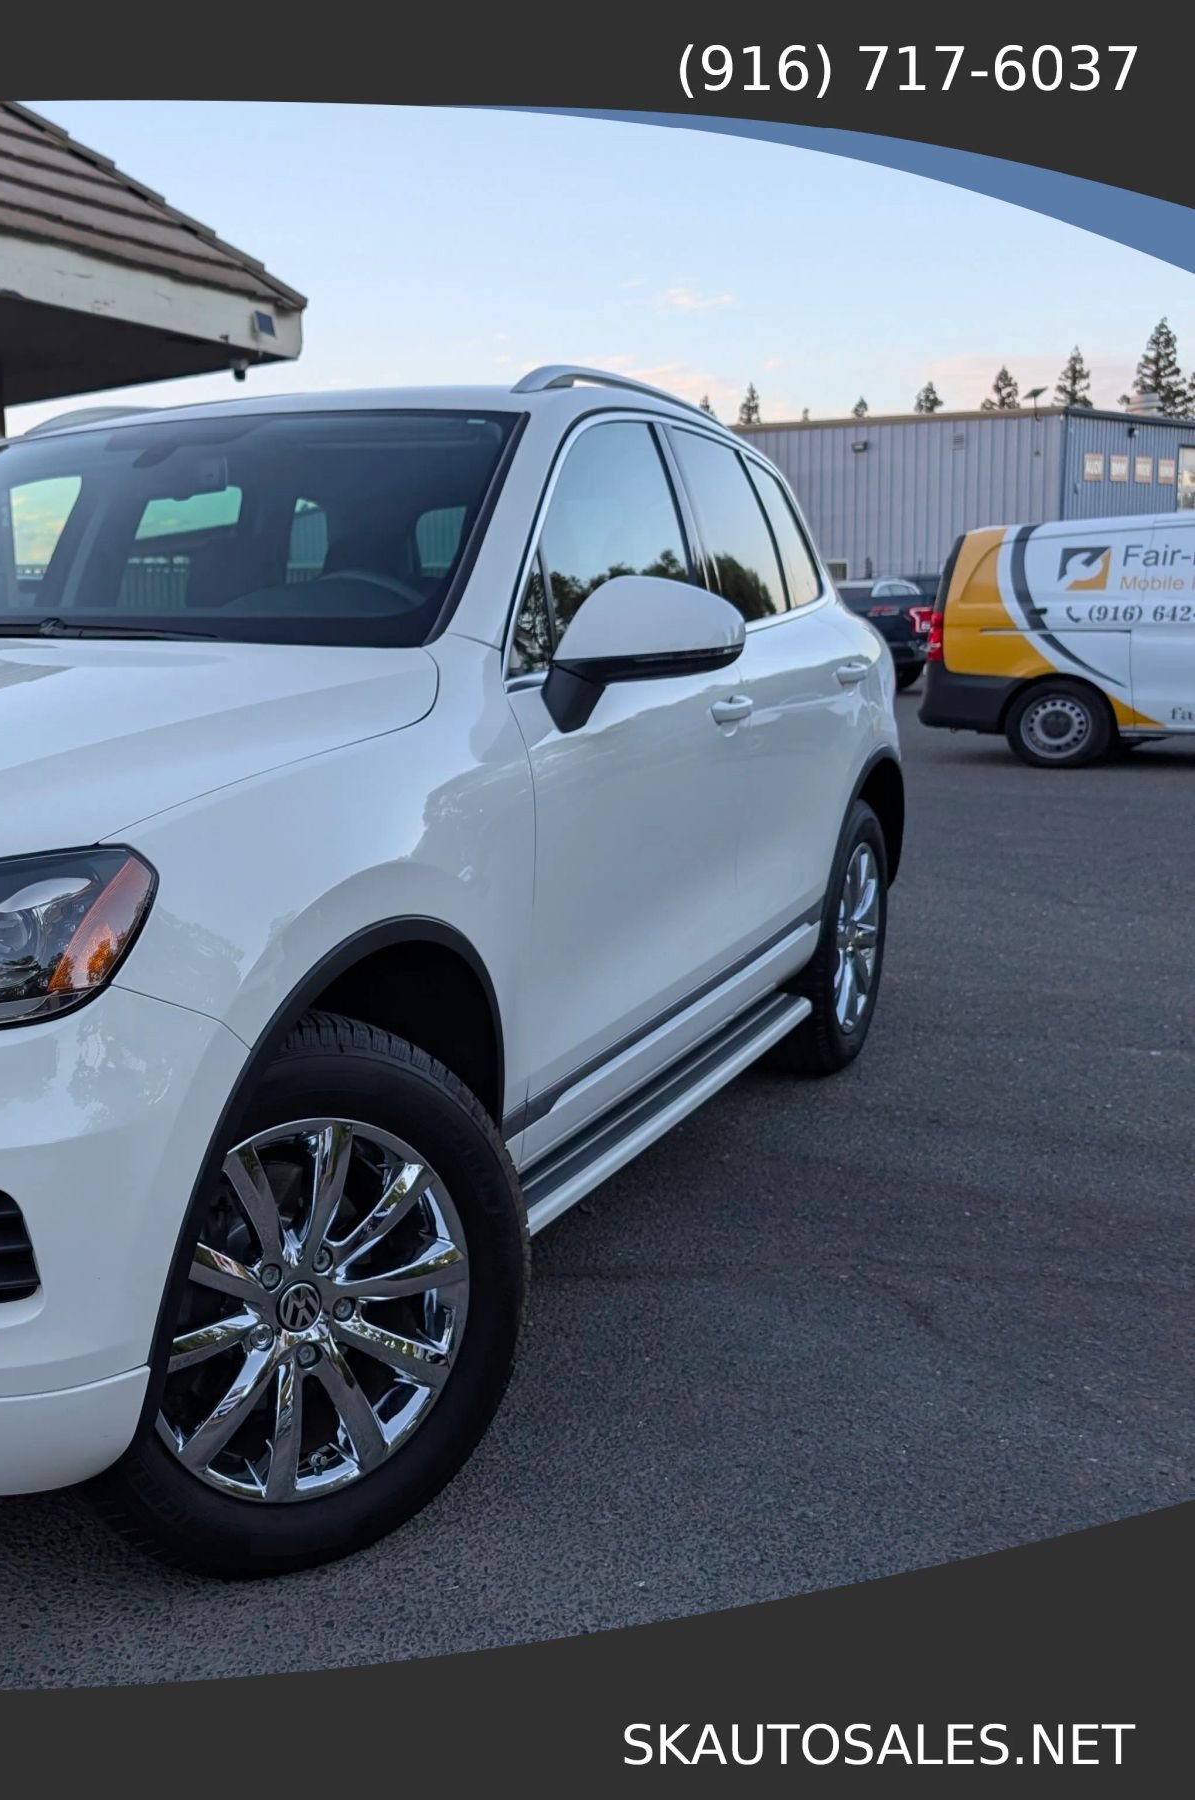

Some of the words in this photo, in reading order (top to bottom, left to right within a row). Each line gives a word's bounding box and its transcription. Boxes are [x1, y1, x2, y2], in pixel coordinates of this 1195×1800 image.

[1122, 543, 1195, 568] Fair-
[1119, 575, 1185, 592] Mobile
[1088, 604, 1143, 623] (916)
